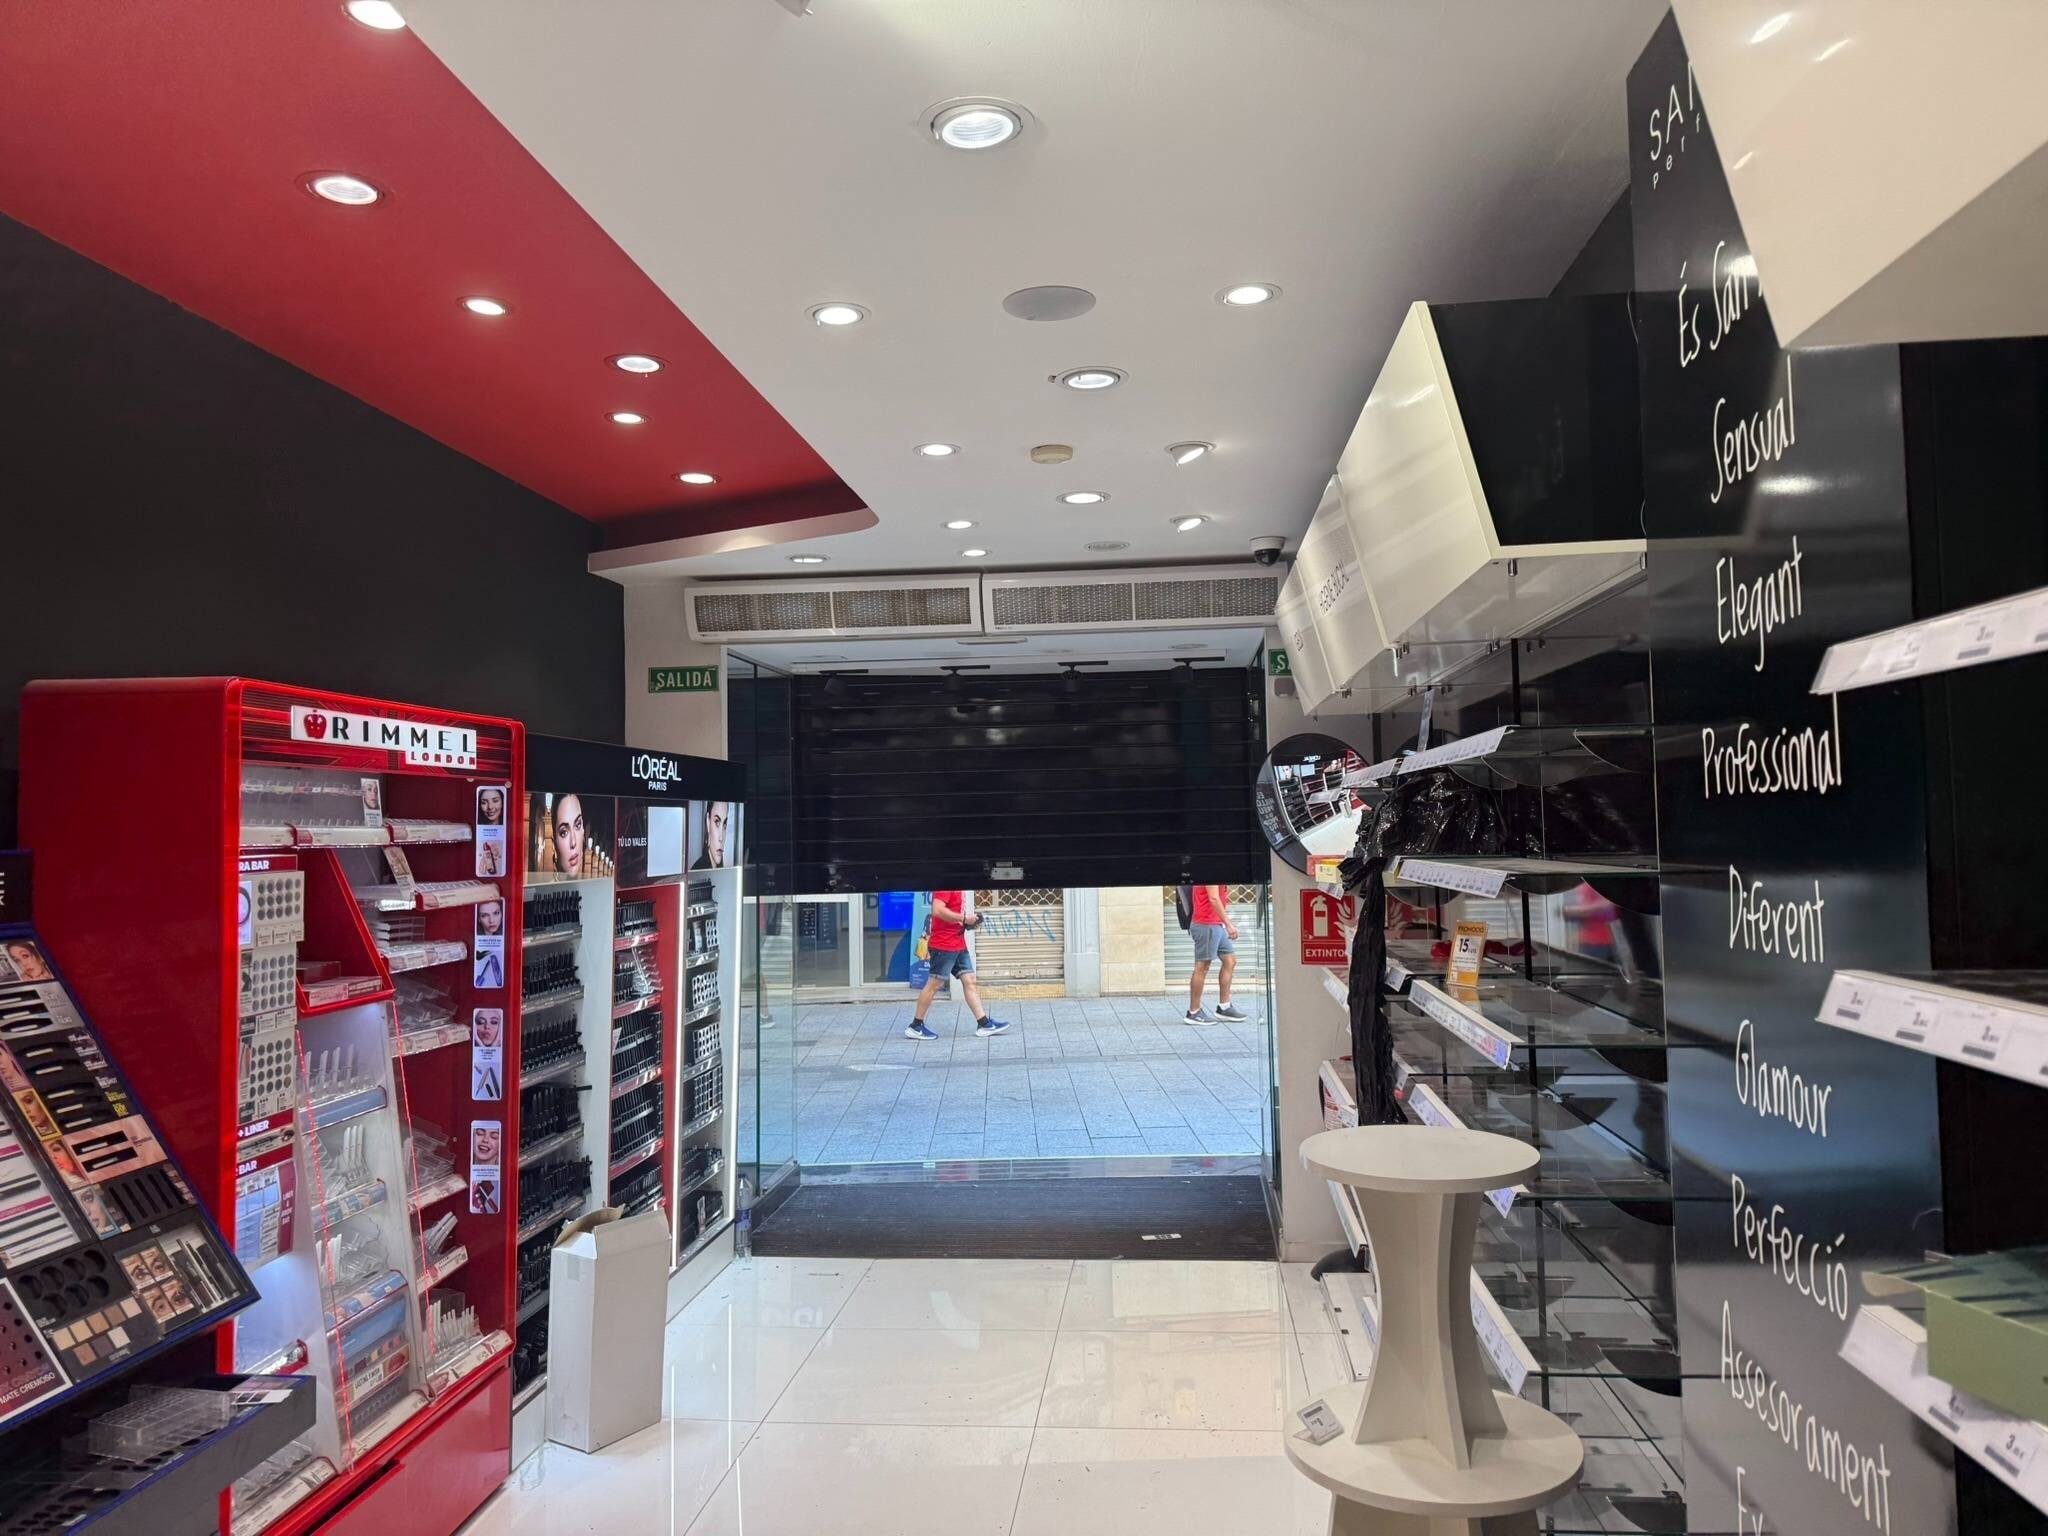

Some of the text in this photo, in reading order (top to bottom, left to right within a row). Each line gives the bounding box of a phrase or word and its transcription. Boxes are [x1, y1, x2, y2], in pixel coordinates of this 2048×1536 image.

[1678, 260, 1701, 368] És
[1710, 354, 1795, 503] Sensual
[1716, 535, 1802, 672] Elegant
[656, 671, 713, 689] SALIDA
[331, 716, 477, 754] RIMMEL
[1702, 689, 1842, 799] Professional
[410, 751, 476, 766] LONDON
[631, 754, 682, 781] L'ORÉAL
[648, 780, 667, 791] PARIS
[251, 860, 270, 871] BAR
[1729, 864, 1825, 963] Diferent
[1305, 948, 1346, 957] EXTINTO
[1735, 1019, 1832, 1138] Glamour
[244, 1120, 270, 1136] LINER
[239, 1160, 257, 1175] BAR
[1732, 1174, 1848, 1321] Perfecció
[20, 1371, 56, 1394] CREMOSO
